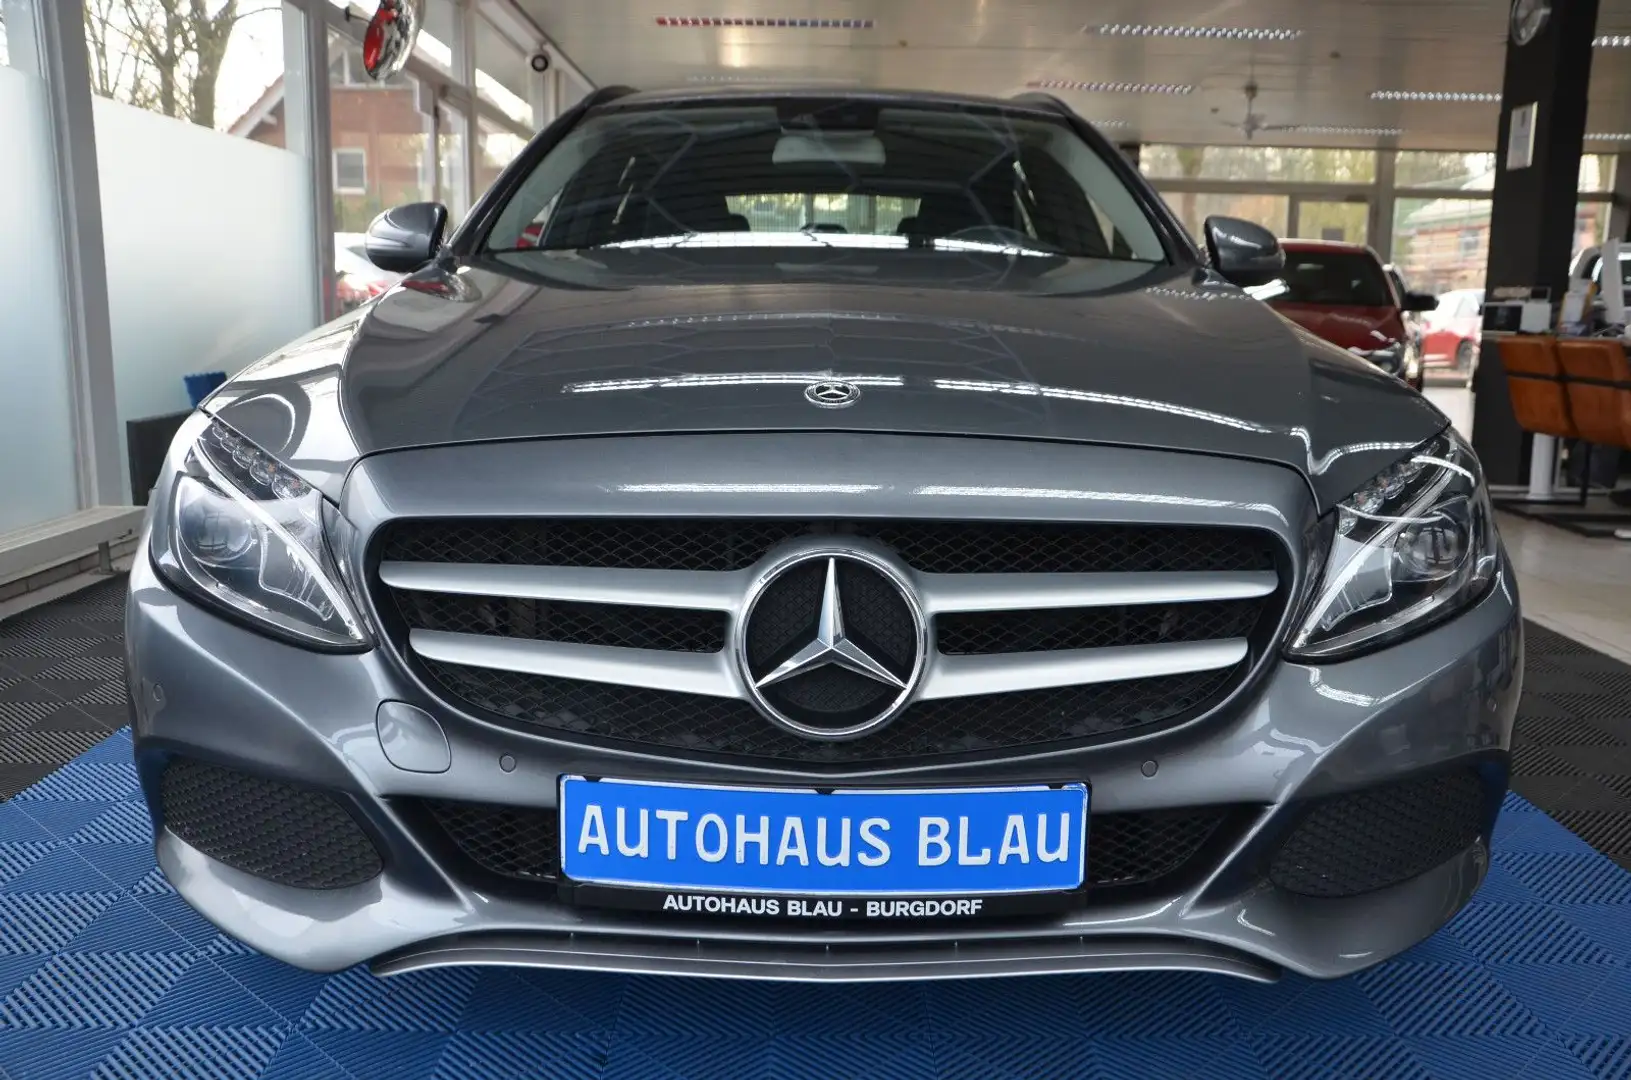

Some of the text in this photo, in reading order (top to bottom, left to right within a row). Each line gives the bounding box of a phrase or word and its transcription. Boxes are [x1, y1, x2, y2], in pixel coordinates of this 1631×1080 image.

[577, 804, 1071, 867] AUTOHAUS BLAU
[662, 895, 780, 915] AUTOHAUS
[787, 899, 843, 917] BLAU
[866, 898, 983, 917] BURGDORF
